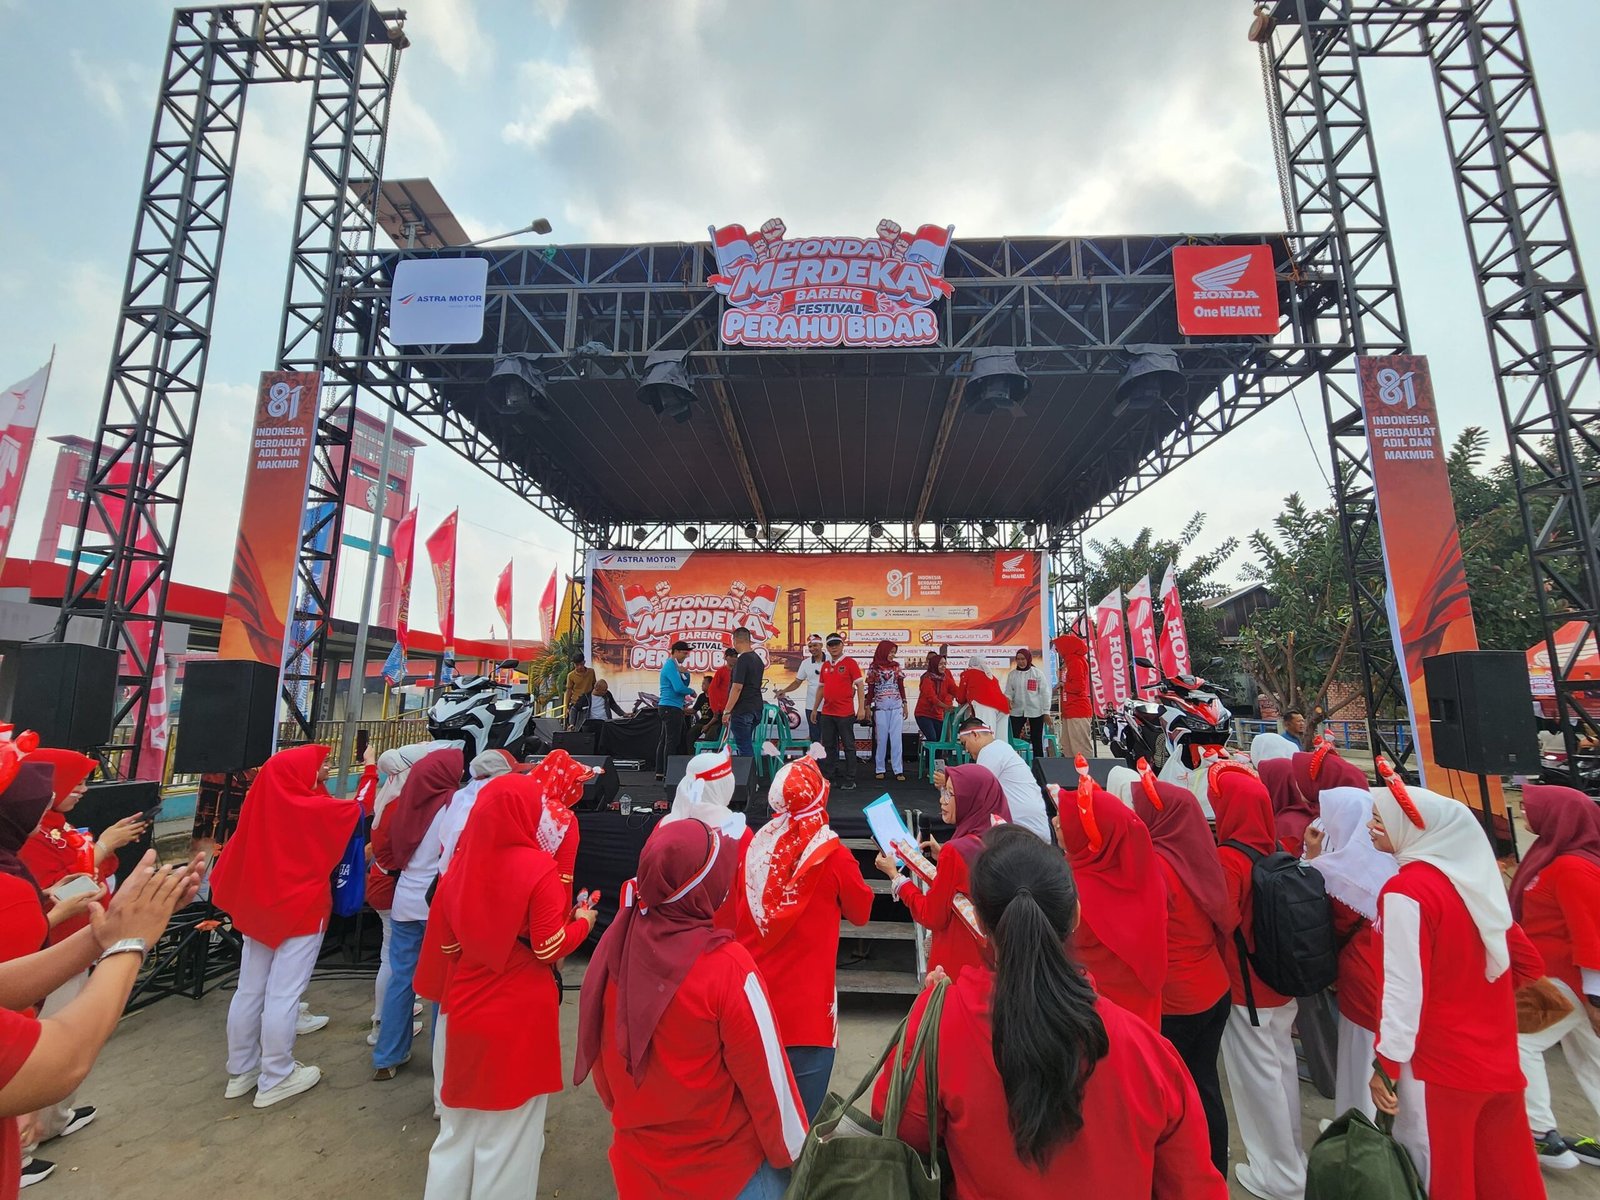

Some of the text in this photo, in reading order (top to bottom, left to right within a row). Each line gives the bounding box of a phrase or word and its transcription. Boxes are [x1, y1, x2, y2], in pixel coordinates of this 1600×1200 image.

[777, 240, 884, 258] HONDA
[732, 258, 932, 300] MERDEKA
[795, 289, 862, 301] BARENG
[1193, 290, 1259, 299] HONDA
[796, 303, 862, 315] FESTIVAL
[1194, 306, 1262, 318] One HEART.
[725, 313, 938, 339] PERAHU BIDAR
[1376, 368, 1417, 410] 81
[267, 382, 304, 421] 81
[1372, 415, 1430, 425] INDONESIA
[256, 427, 304, 436] INDONESIA
[1374, 427, 1436, 437] BERDAULAT
[254, 438, 307, 448] BERDAULAT
[1383, 437, 1432, 447] ADIL DAN
[258, 447, 300, 457] ADIL DAN
[1384, 450, 1434, 460] MAKMUR
[256, 459, 299, 469] MAKMUR
[886, 569, 913, 600] 81
[666, 596, 734, 610] HONDA
[638, 611, 766, 638] MERDEKA
[678, 631, 722, 640] BARENG
[687, 642, 723, 650] ESTIVAL
[633, 649, 708, 668] PERHU
